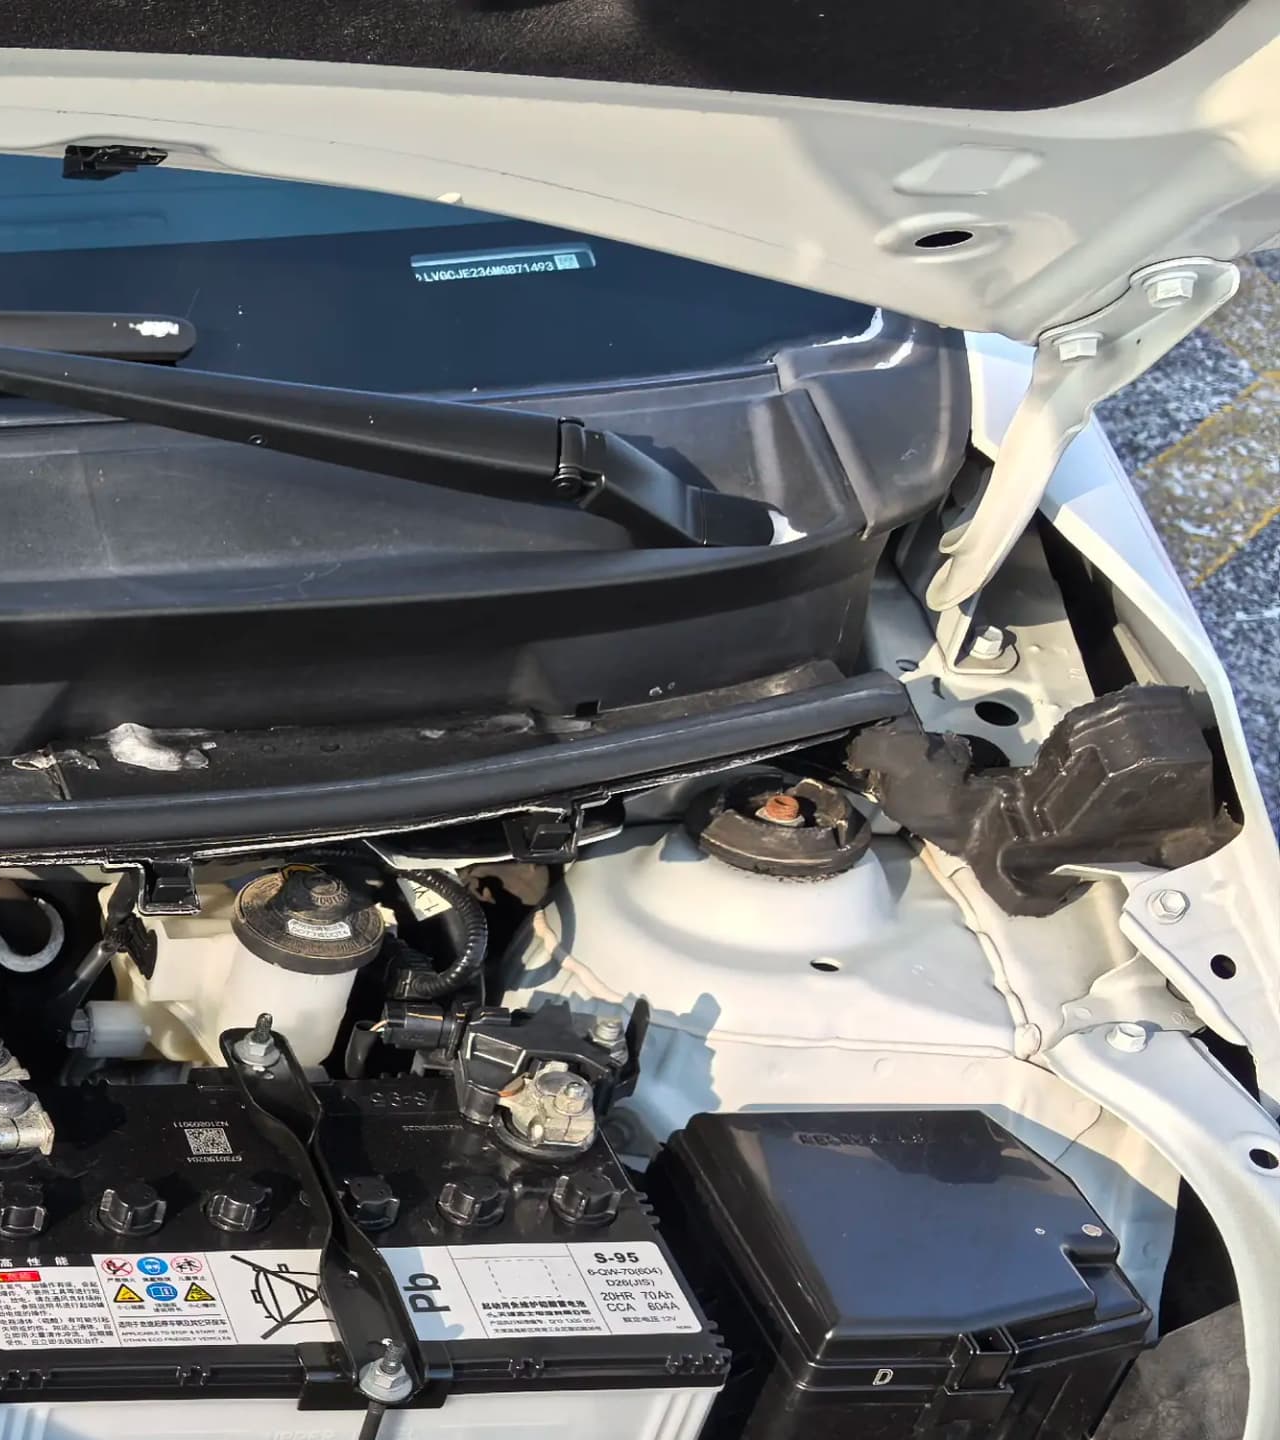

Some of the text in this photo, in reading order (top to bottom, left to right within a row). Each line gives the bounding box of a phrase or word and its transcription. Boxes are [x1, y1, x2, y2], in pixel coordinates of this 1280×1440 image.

[594, 1252, 639, 1263] S-95
[403, 1272, 451, 1313] Pb
[600, 1291, 674, 1301] 20HR 70Ah
[606, 1302, 680, 1312] CCA 604A
[873, 1368, 893, 1385] D
